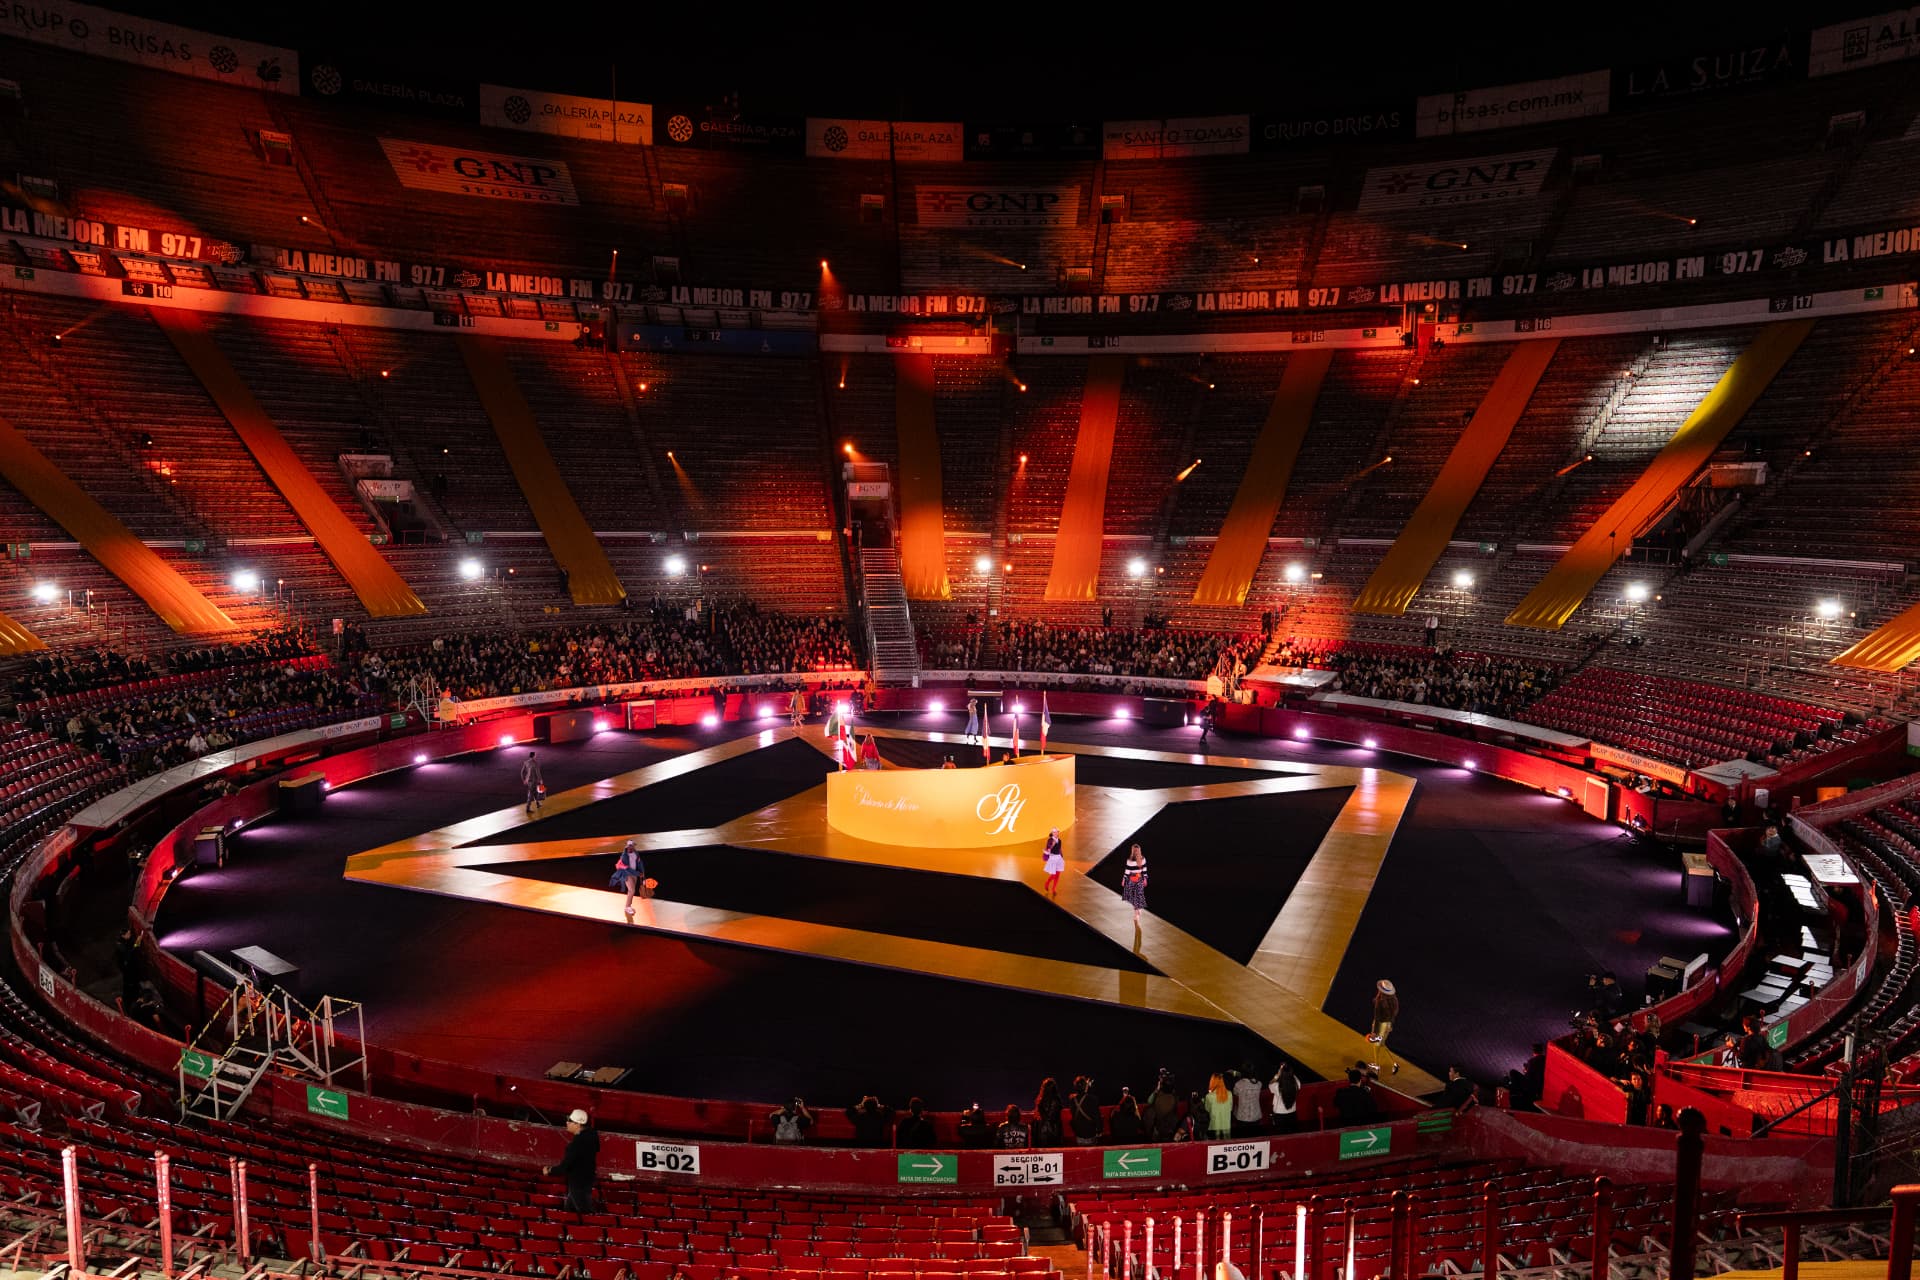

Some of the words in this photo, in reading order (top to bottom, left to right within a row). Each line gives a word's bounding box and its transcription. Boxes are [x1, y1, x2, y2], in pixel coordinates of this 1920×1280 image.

[1877, 18, 1920, 43] AL
[108, 26, 192, 61] BRISAS
[1626, 65, 1669, 96] LA
[1690, 43, 1792, 87] SUIZA
[543, 103, 600, 121] GALERÍA
[602, 111, 645, 125] PLAZA
[1438, 90, 1583, 122] brisas.com.mx
[913, 132, 953, 144] PLAZA
[1264, 119, 1328, 141] GRUPO
[1333, 112, 1400, 136] BRISAS
[454, 157, 556, 186] GNP
[1426, 161, 1537, 190] GNP
[967, 192, 1059, 213] GNP
[2, 206, 30, 232] LA
[33, 213, 105, 246] MEJOR
[118, 226, 149, 252] FM
[161, 233, 202, 259] 97.7
[1823, 238, 1849, 264] LA
[282, 249, 305, 272] LA
[308, 252, 368, 279] MEJOR
[375, 261, 400, 282] FM
[411, 265, 446, 287] 97.7
[1582, 267, 1604, 289] LA
[1608, 261, 1670, 286] MEJOR
[1675, 256, 1704, 280] FM
[1722, 249, 1764, 275] 97.7
[157, 285, 172, 298] 10
[486, 271, 507, 292] LA
[509, 274, 563, 297] MEJOR
[570, 279, 593, 298] FM
[602, 281, 634, 301] 97.7
[672, 285, 690, 304] LA
[693, 287, 743, 306] MEJOR
[751, 290, 773, 308] FM
[1380, 283, 1401, 303] LA
[1403, 280, 1460, 301] MEJOR
[1466, 276, 1493, 297] FM
[1502, 273, 1538, 295] 97.7
[848, 294, 866, 312] LA
[869, 295, 919, 313] MEJOR
[925, 295, 947, 313] FM
[956, 295, 986, 313] 97.7
[1023, 296, 1041, 313] LA
[1043, 296, 1092, 313] MEJOR
[1098, 295, 1120, 313] FM
[1129, 294, 1160, 312] 97.7
[1197, 293, 1215, 311] LA
[1218, 291, 1269, 311] MEJOR
[1275, 289, 1299, 308] FM
[1308, 288, 1340, 307] 97.7
[1798, 295, 1812, 309] 17
[642, 1151, 695, 1171] B-02
[1032, 1163, 1058, 1173] B-01
[1213, 1151, 1263, 1172] B-01
[997, 1174, 1025, 1184] B-02
